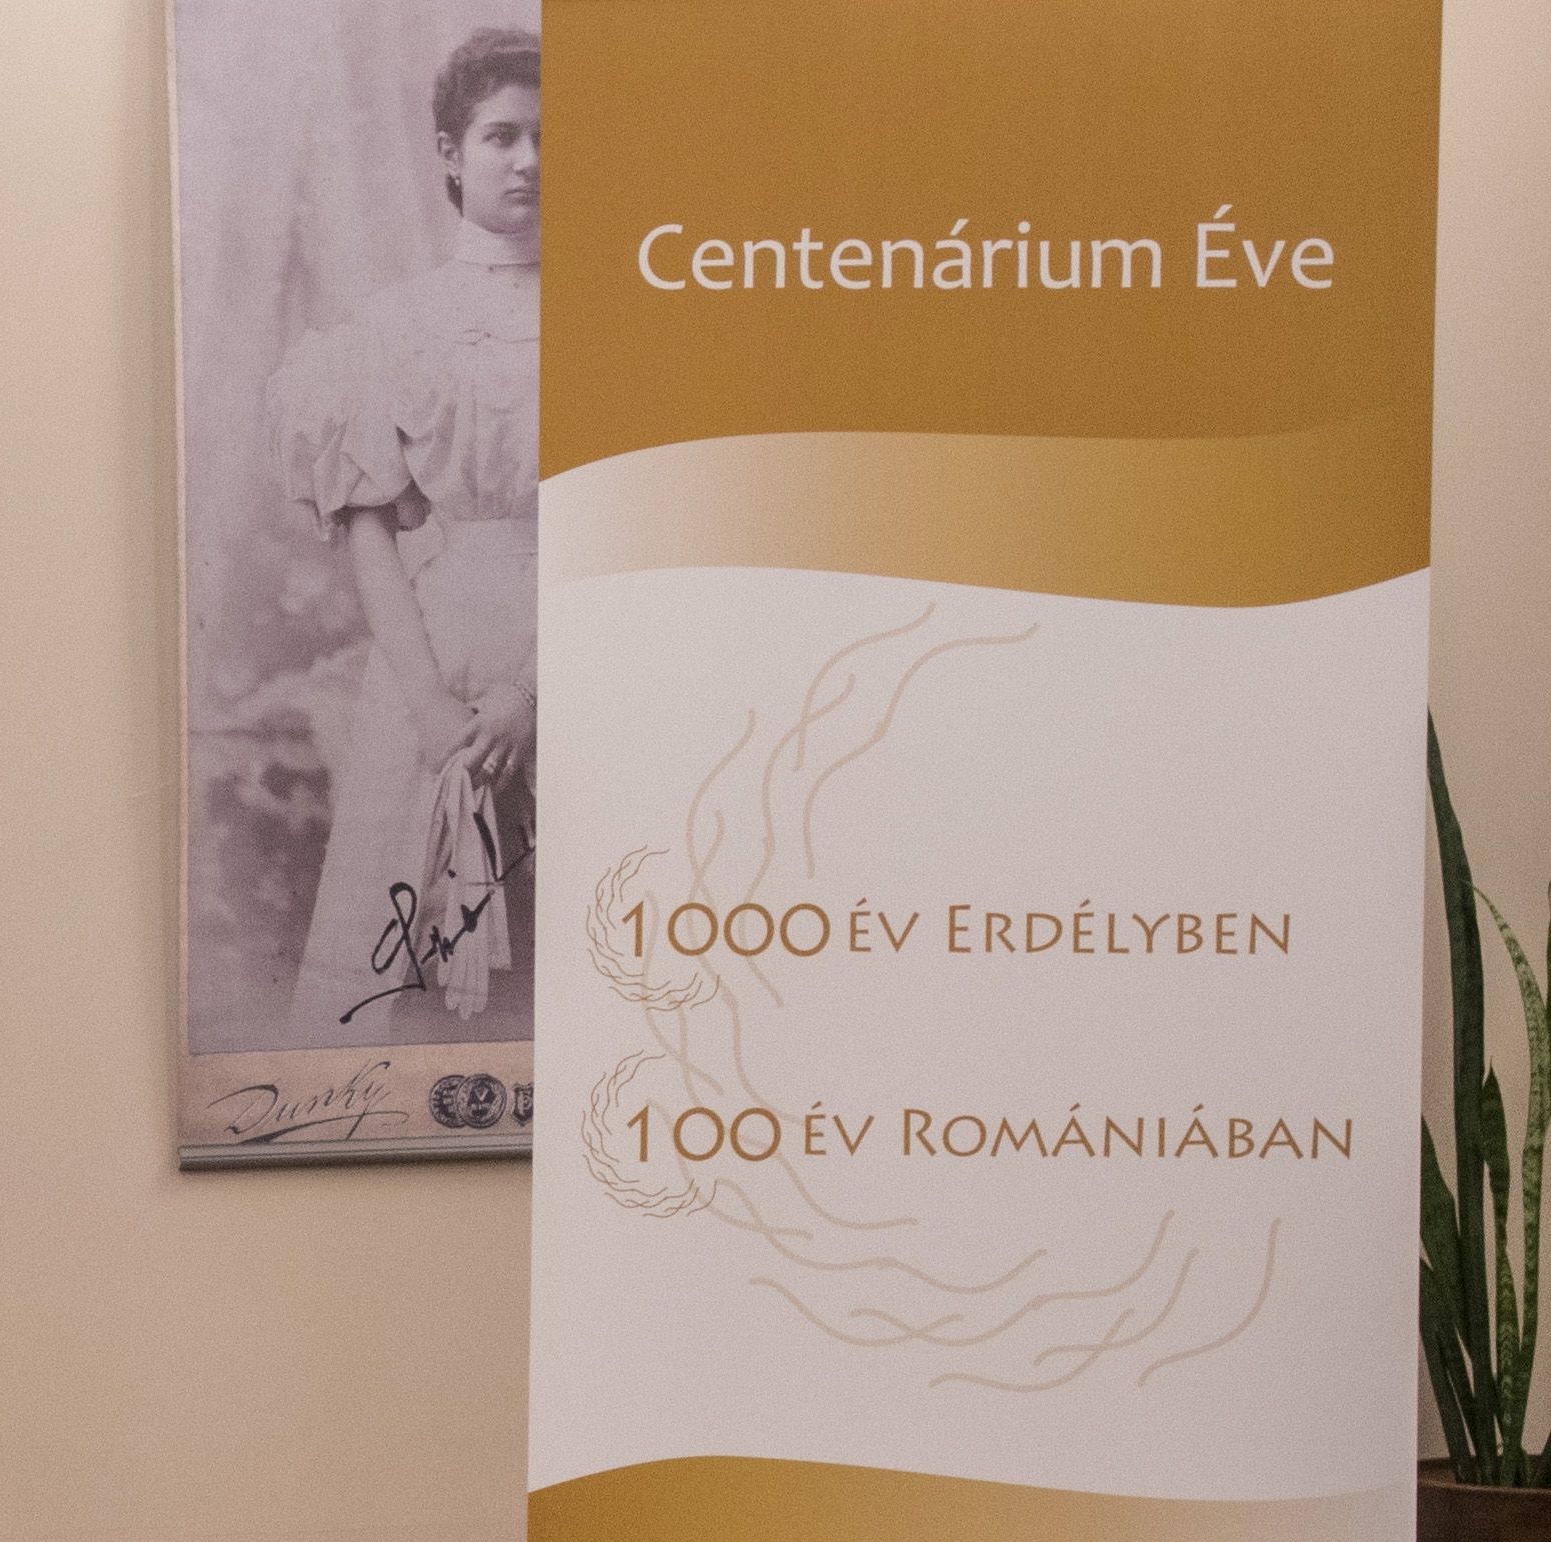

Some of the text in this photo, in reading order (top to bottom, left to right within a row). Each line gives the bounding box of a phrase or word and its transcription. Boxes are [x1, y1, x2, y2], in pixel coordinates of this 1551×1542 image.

[639, 205, 1334, 290] Centenárium Éve
[622, 901, 831, 959] 1000
[850, 899, 920, 954] ÉV
[626, 1106, 783, 1163] 100
[804, 1102, 875, 1157] ÉV
